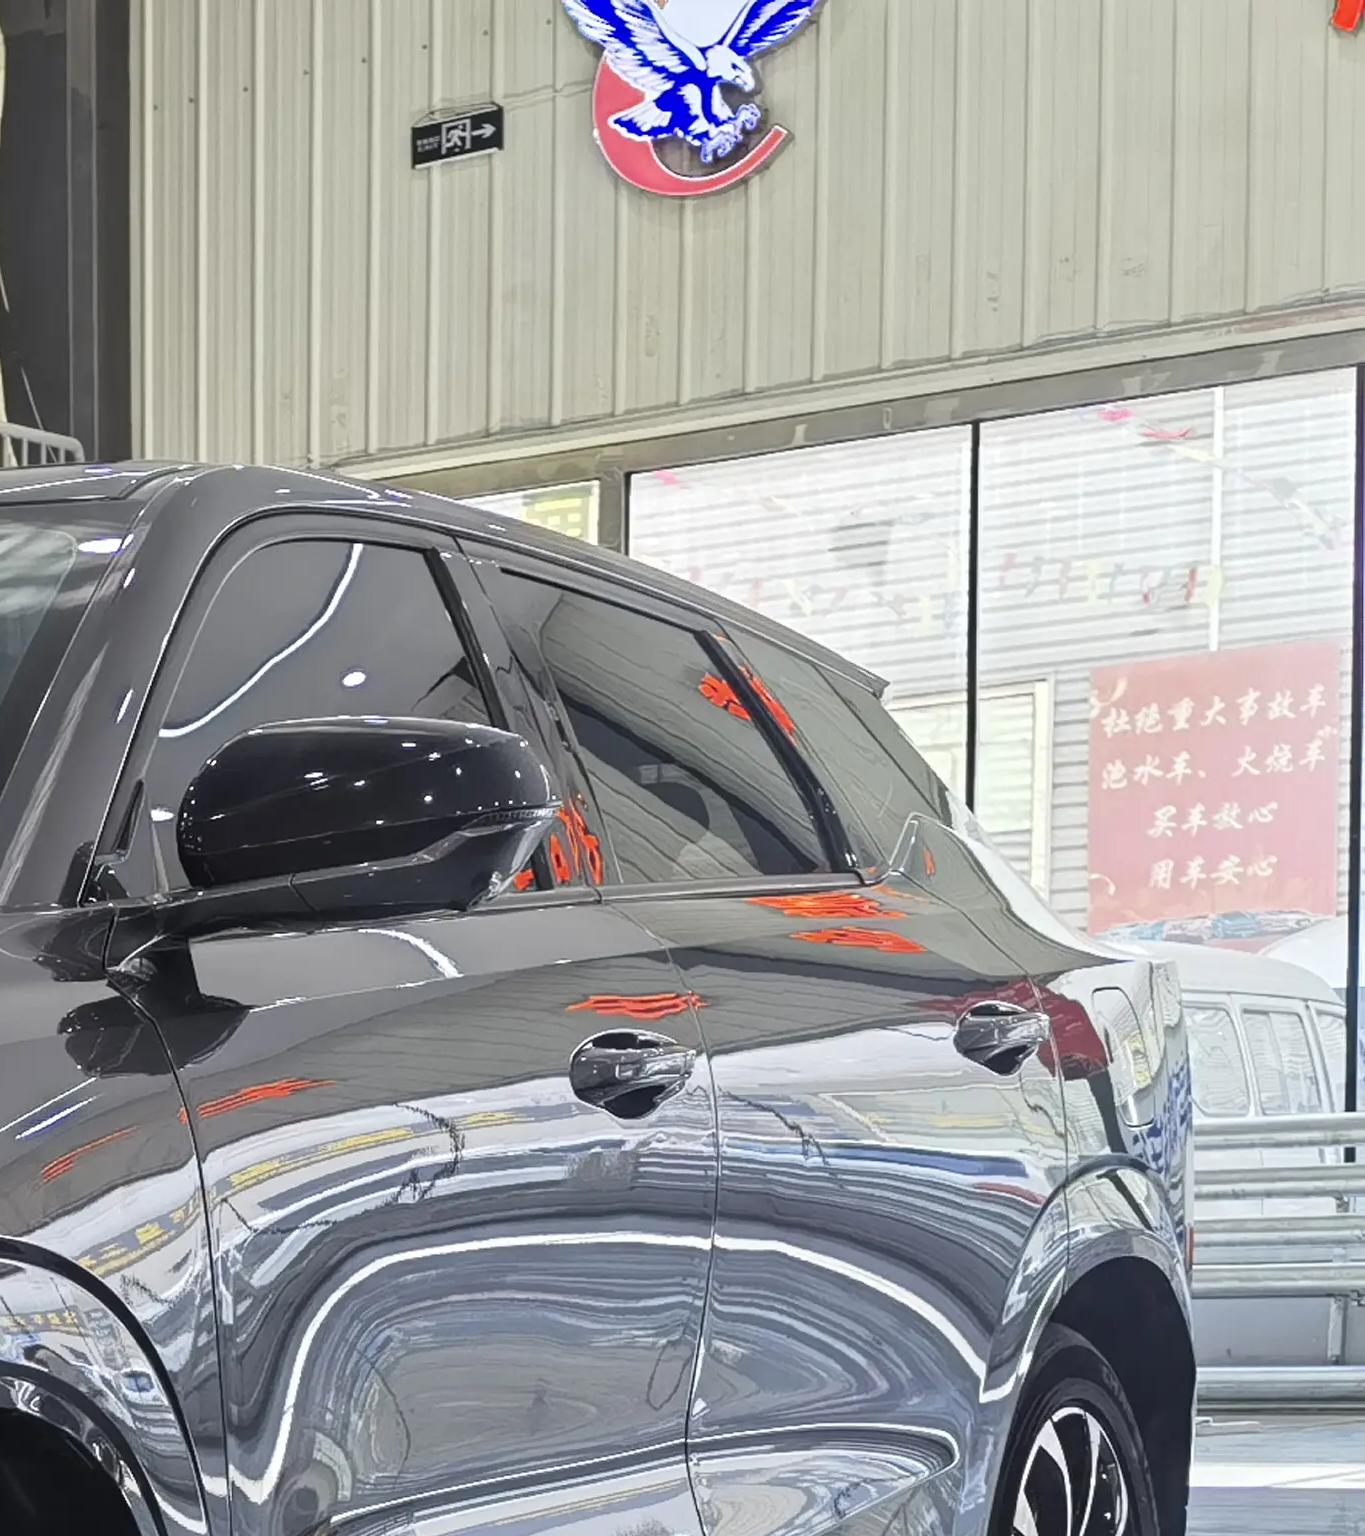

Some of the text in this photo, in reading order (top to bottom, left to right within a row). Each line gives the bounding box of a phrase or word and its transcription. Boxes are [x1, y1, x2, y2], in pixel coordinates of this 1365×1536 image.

[1101, 683, 1327, 739] 杜绝重大事故车
[1146, 801, 1278, 838] 买车放心
[1148, 854, 1278, 889] 用车安心
